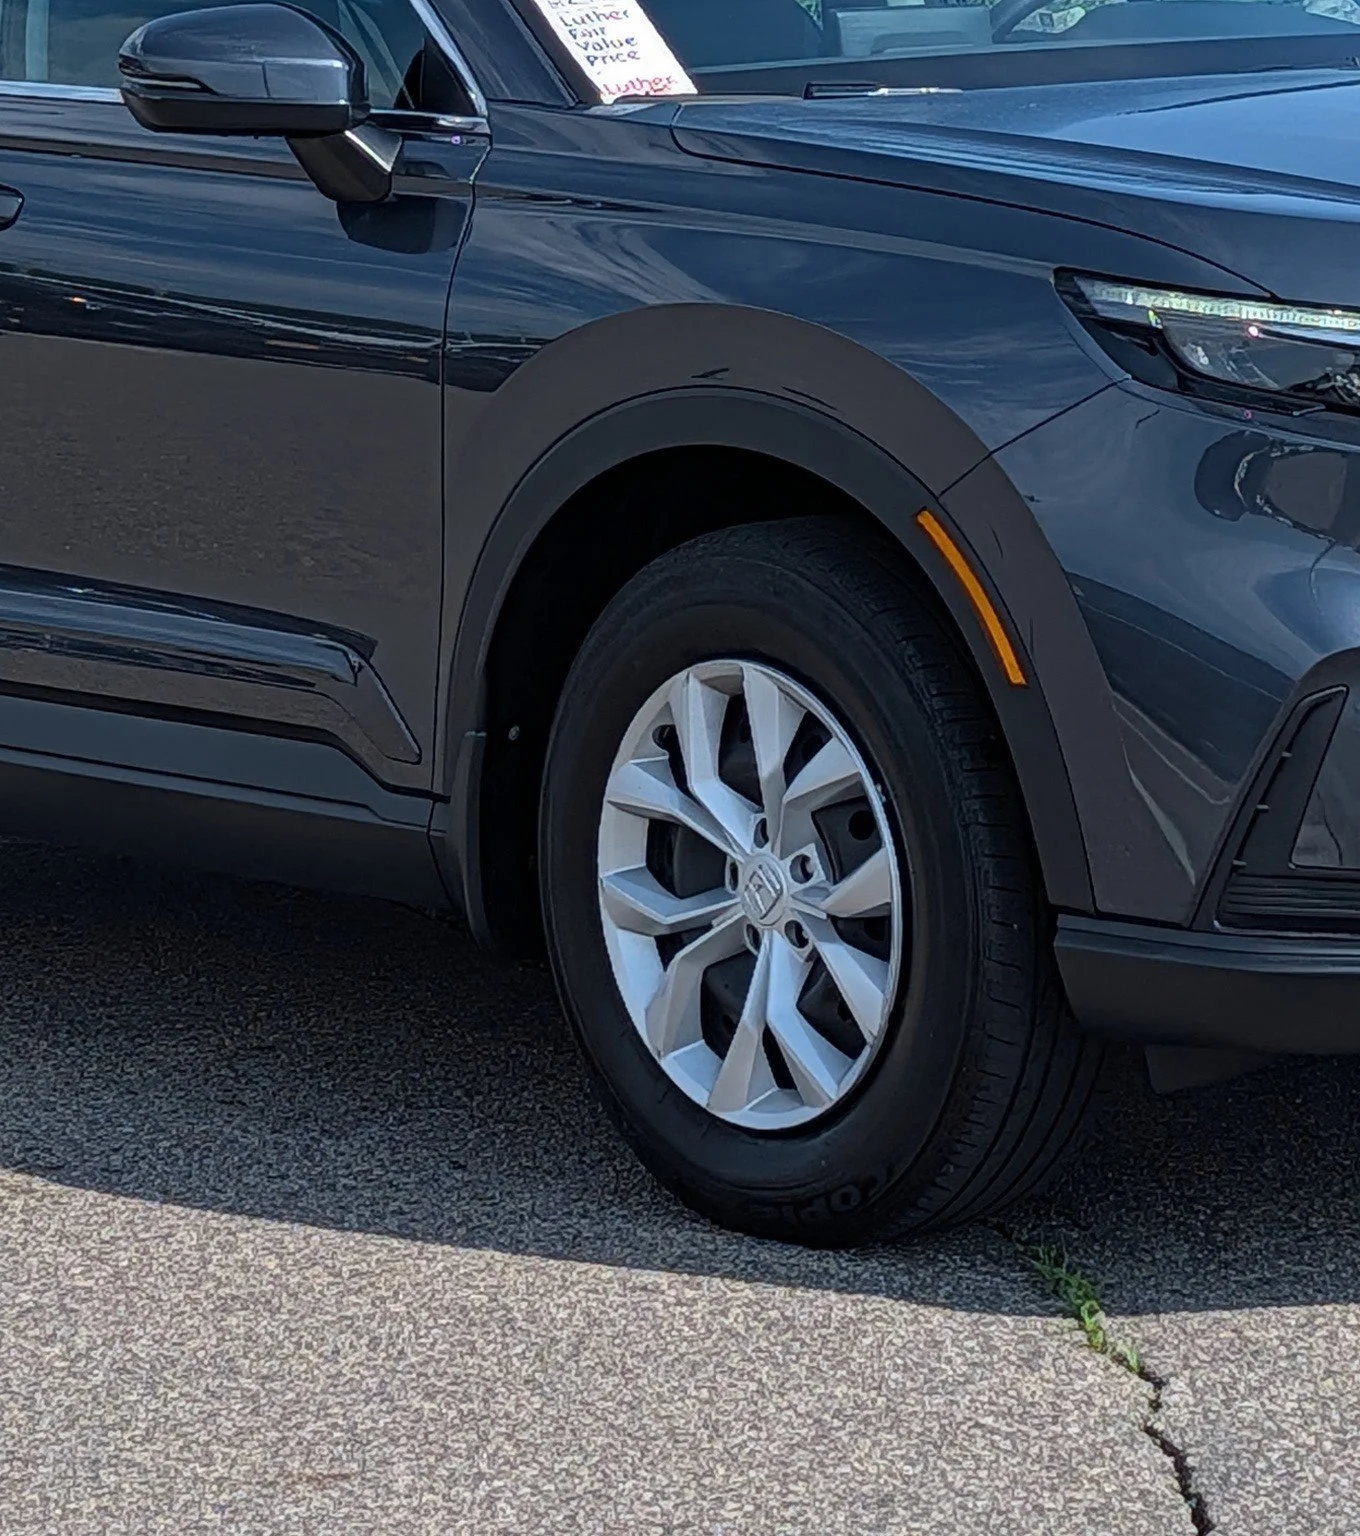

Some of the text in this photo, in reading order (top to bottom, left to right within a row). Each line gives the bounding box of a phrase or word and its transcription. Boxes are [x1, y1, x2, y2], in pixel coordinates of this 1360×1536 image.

[559, 9, 630, 27] Luther
[568, 27, 607, 40] Fair
[584, 50, 641, 66] Price
